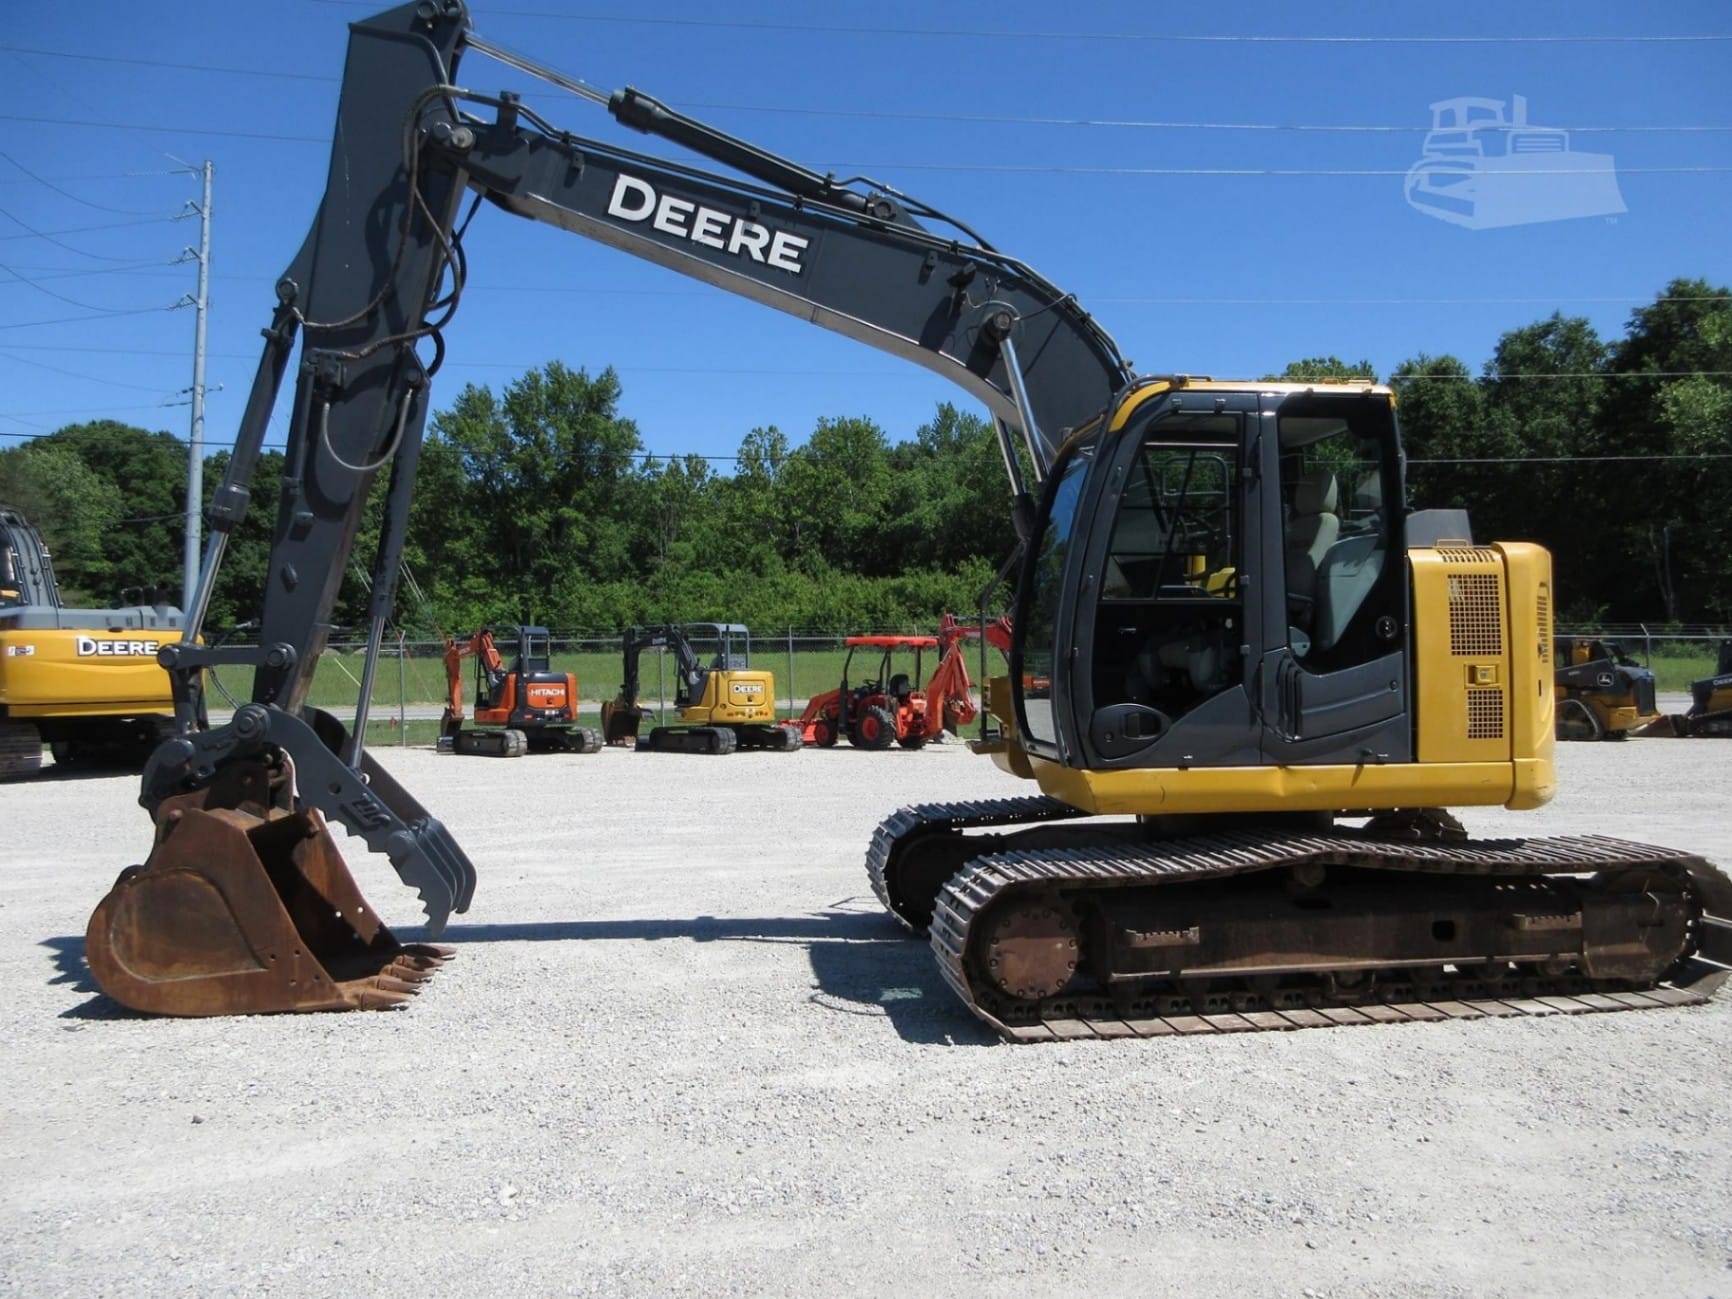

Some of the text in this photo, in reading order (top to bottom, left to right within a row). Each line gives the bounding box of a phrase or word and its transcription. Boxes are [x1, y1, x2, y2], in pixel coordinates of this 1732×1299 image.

[607, 173, 808, 273] DEERE
[77, 635, 158, 656] DEERE
[530, 688, 566, 697] HITACHI
[732, 683, 763, 693] DEERE
